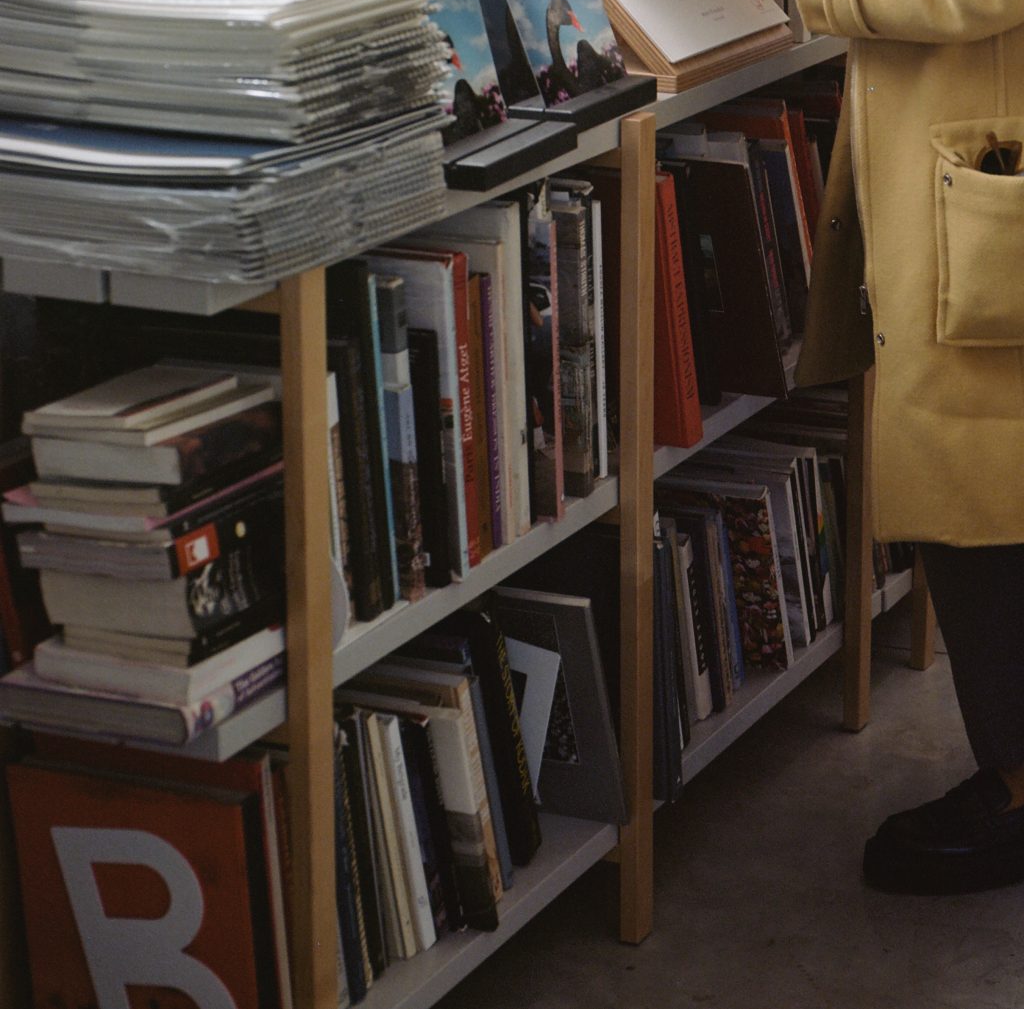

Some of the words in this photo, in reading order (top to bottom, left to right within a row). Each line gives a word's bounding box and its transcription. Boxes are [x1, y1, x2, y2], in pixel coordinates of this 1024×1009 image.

[665, 203, 682, 278] ABSTRACT
[674, 279, 694, 400] EXPRESSIONISM
[458, 342, 470, 383] Atget
[460, 387, 474, 443] Eugène
[497, 631, 507, 665] THE
[502, 665, 519, 720] STORY
[512, 721, 522, 737] OF
[516, 739, 531, 795] KODAK
